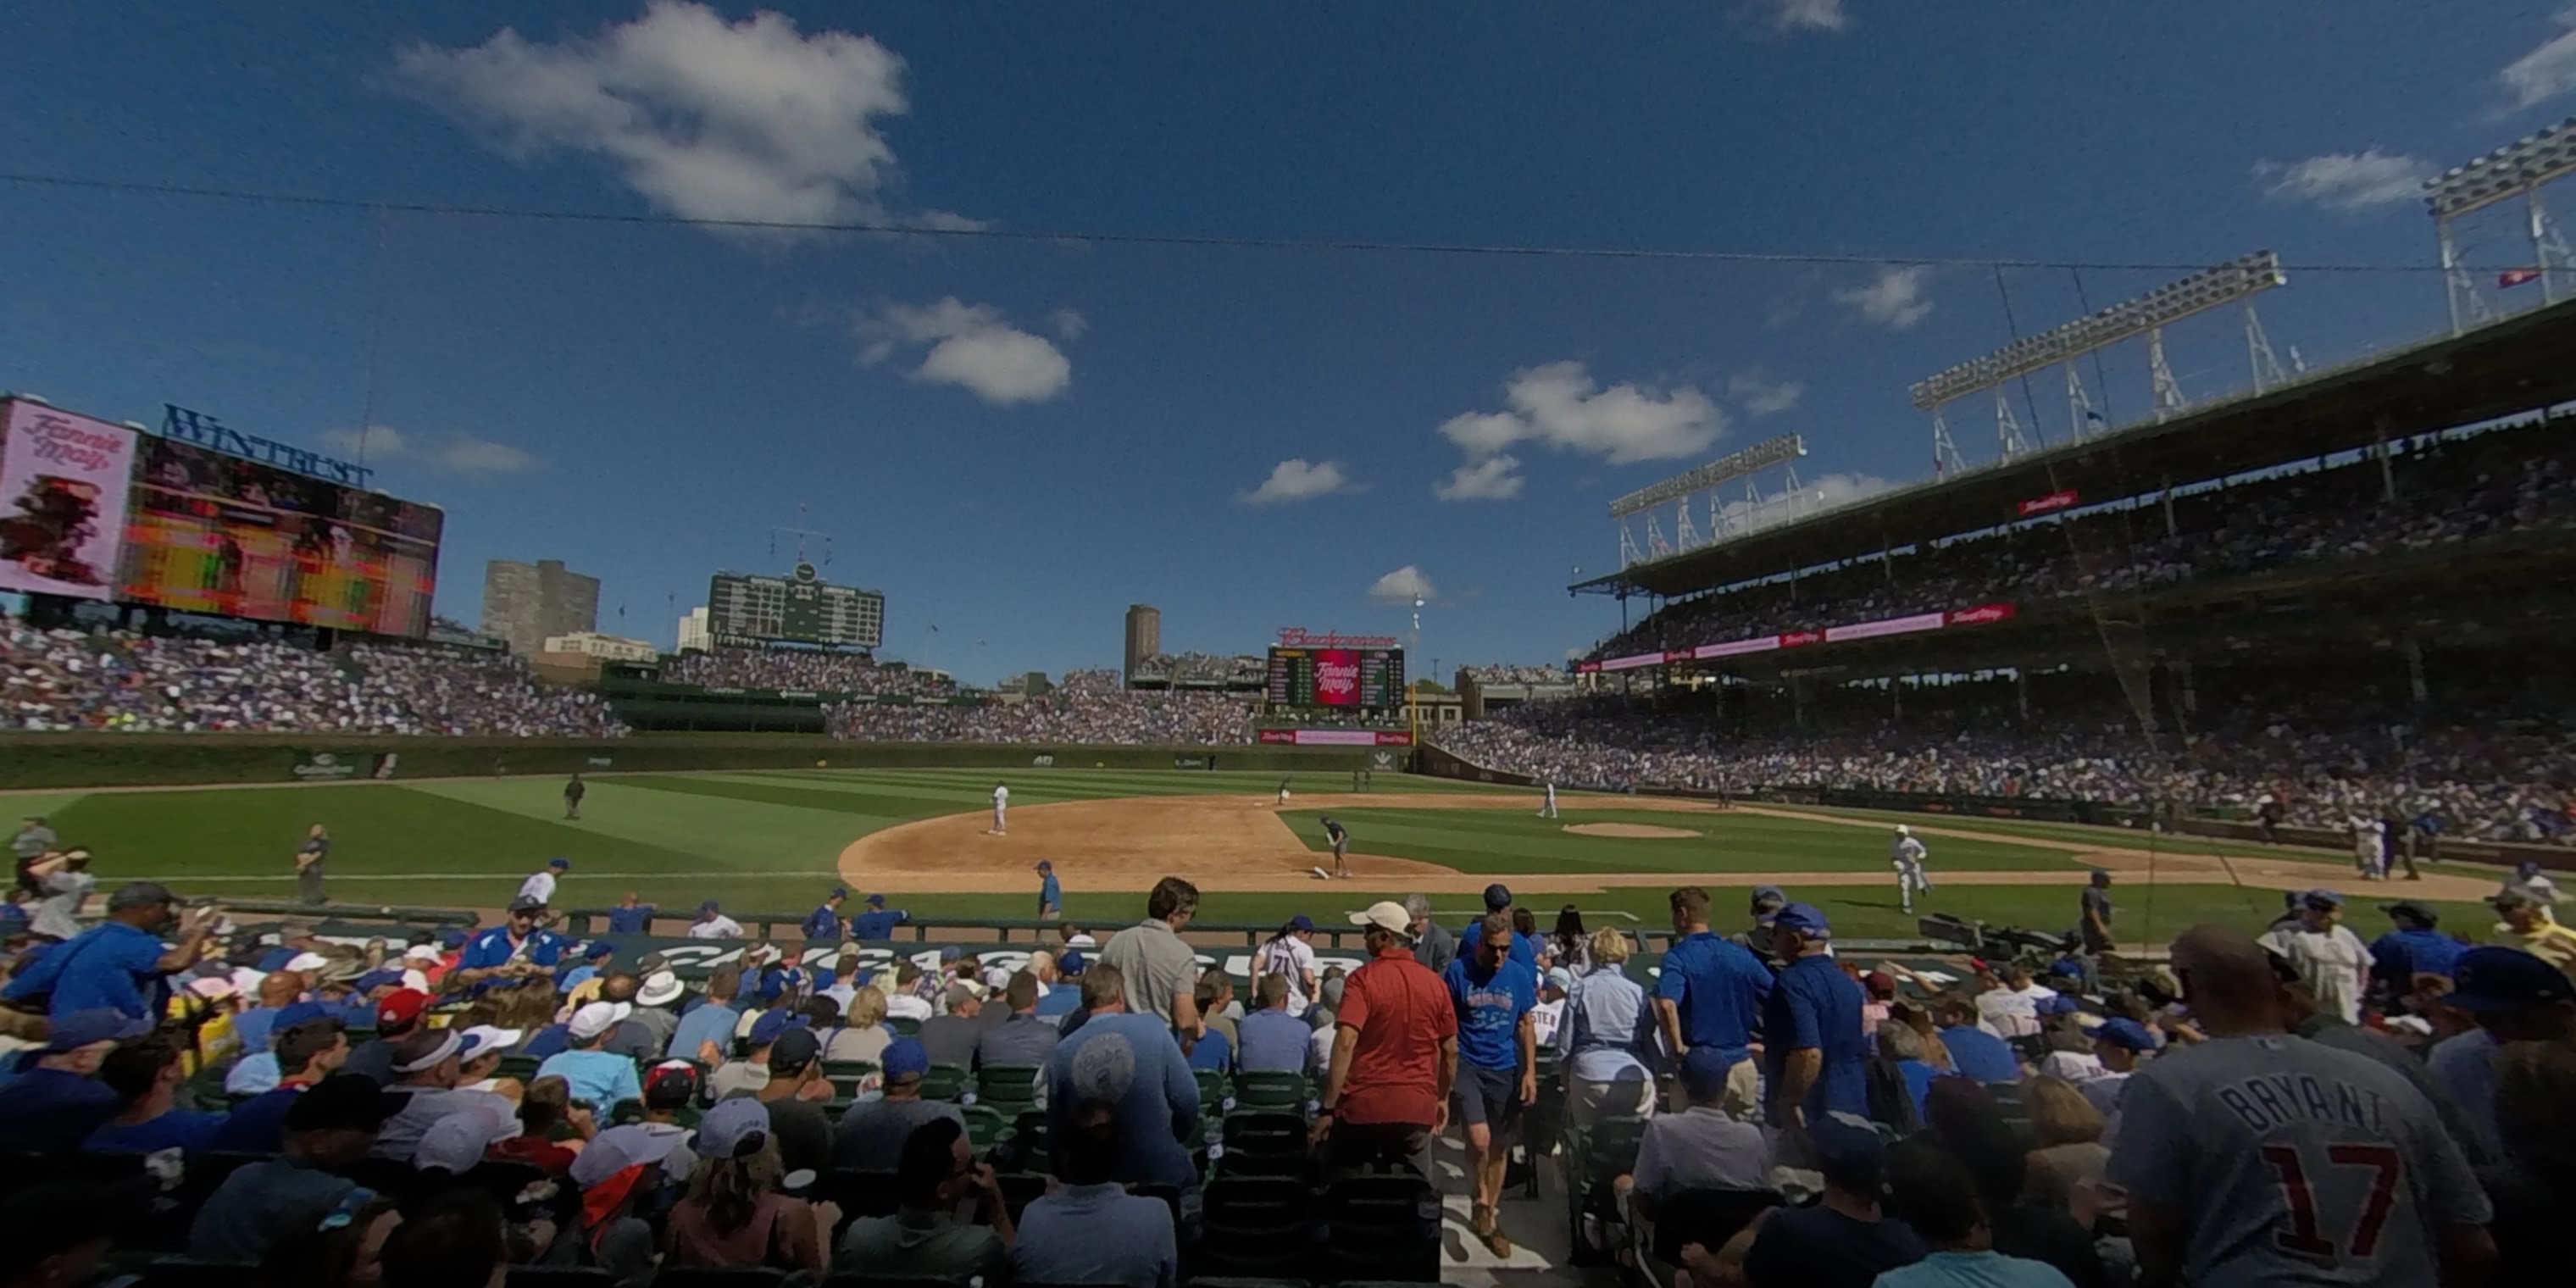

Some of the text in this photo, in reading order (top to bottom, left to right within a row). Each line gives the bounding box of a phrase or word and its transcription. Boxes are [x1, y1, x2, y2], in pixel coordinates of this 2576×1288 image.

[21, 414, 123, 454] Fannie
[32, 436, 110, 471] May
[1314, 662, 1358, 679] Fannie
[1319, 677, 1354, 694] May
[1274, 955, 1290, 976] 71
[2218, 1074, 2385, 1136] BRYANT
[2259, 1144, 2400, 1257] 17
